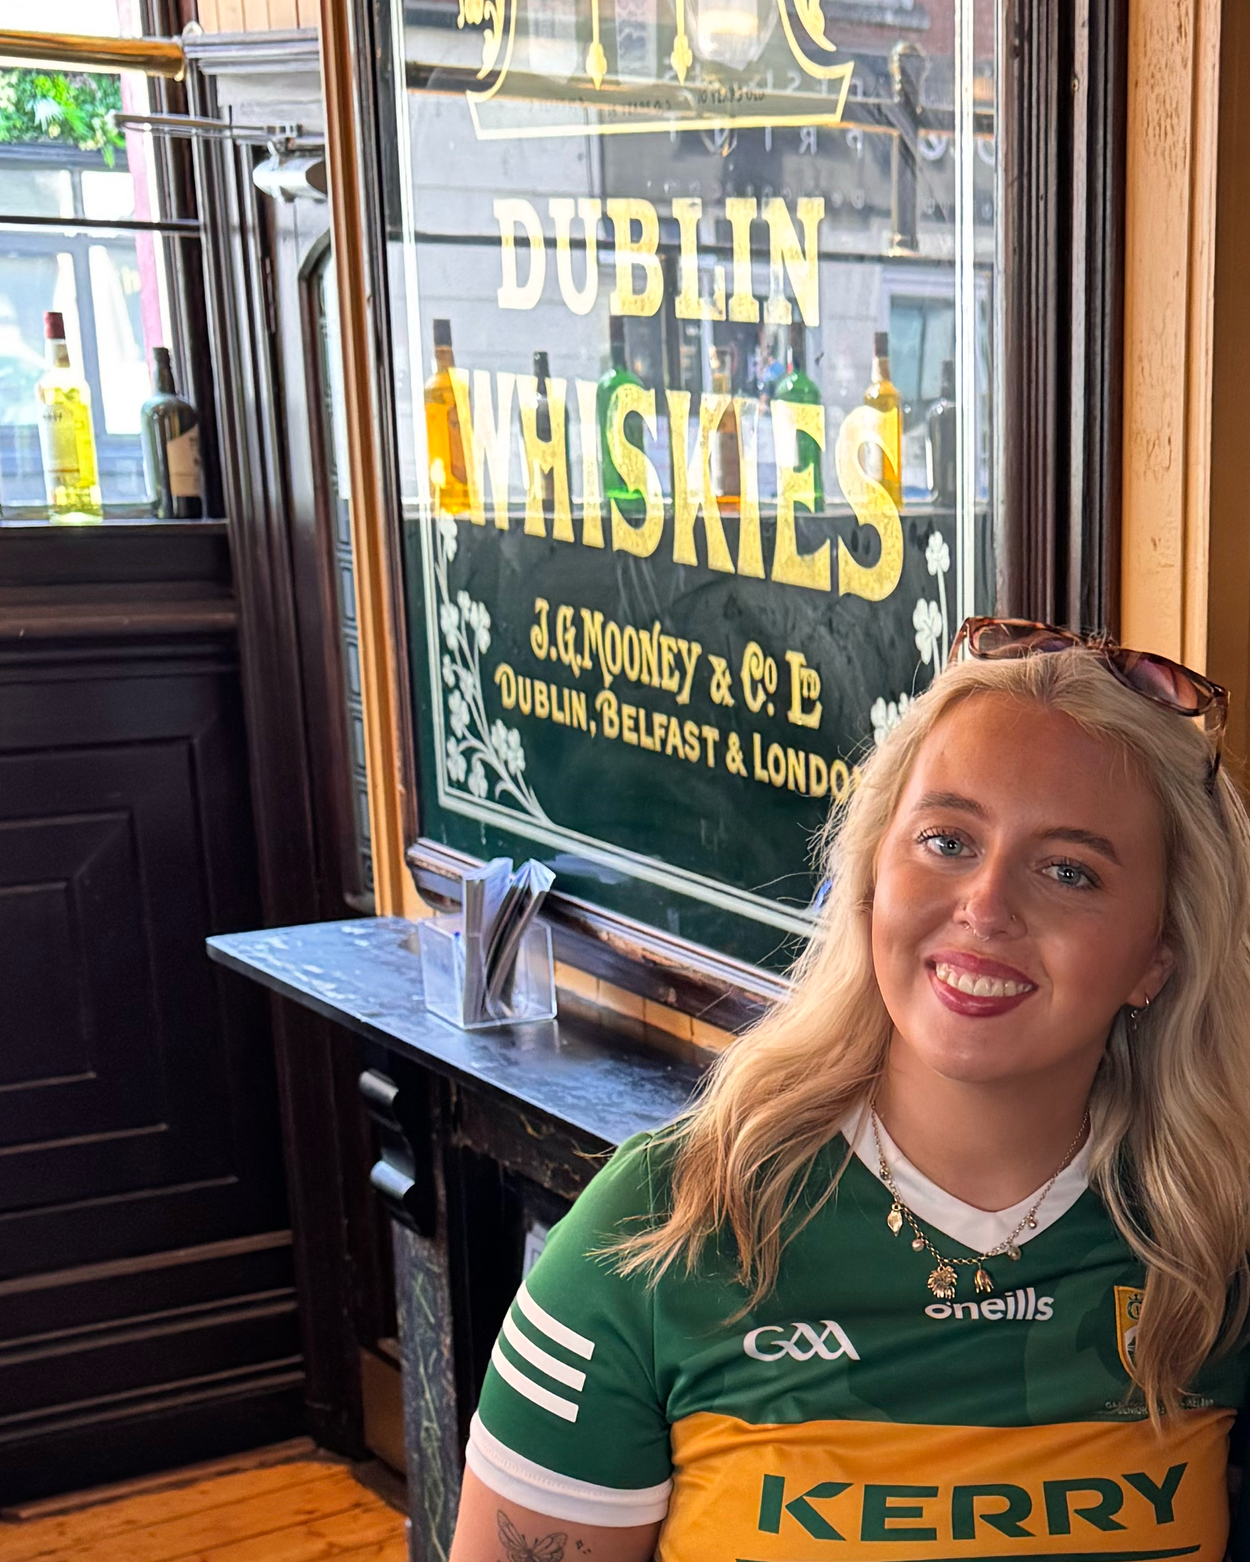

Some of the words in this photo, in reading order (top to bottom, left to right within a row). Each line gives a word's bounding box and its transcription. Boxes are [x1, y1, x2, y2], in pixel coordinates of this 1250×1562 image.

[493, 197, 825, 326] DUBLIN
[448, 366, 904, 602] WHISKIES
[494, 662, 597, 738] DUBLIN,
[595, 689, 720, 768] BELFAST
[725, 732, 748, 778] &
[708, 654, 735, 707] &
[743, 1319, 860, 1361] GAA
[758, 1462, 1189, 1541] KERRY
